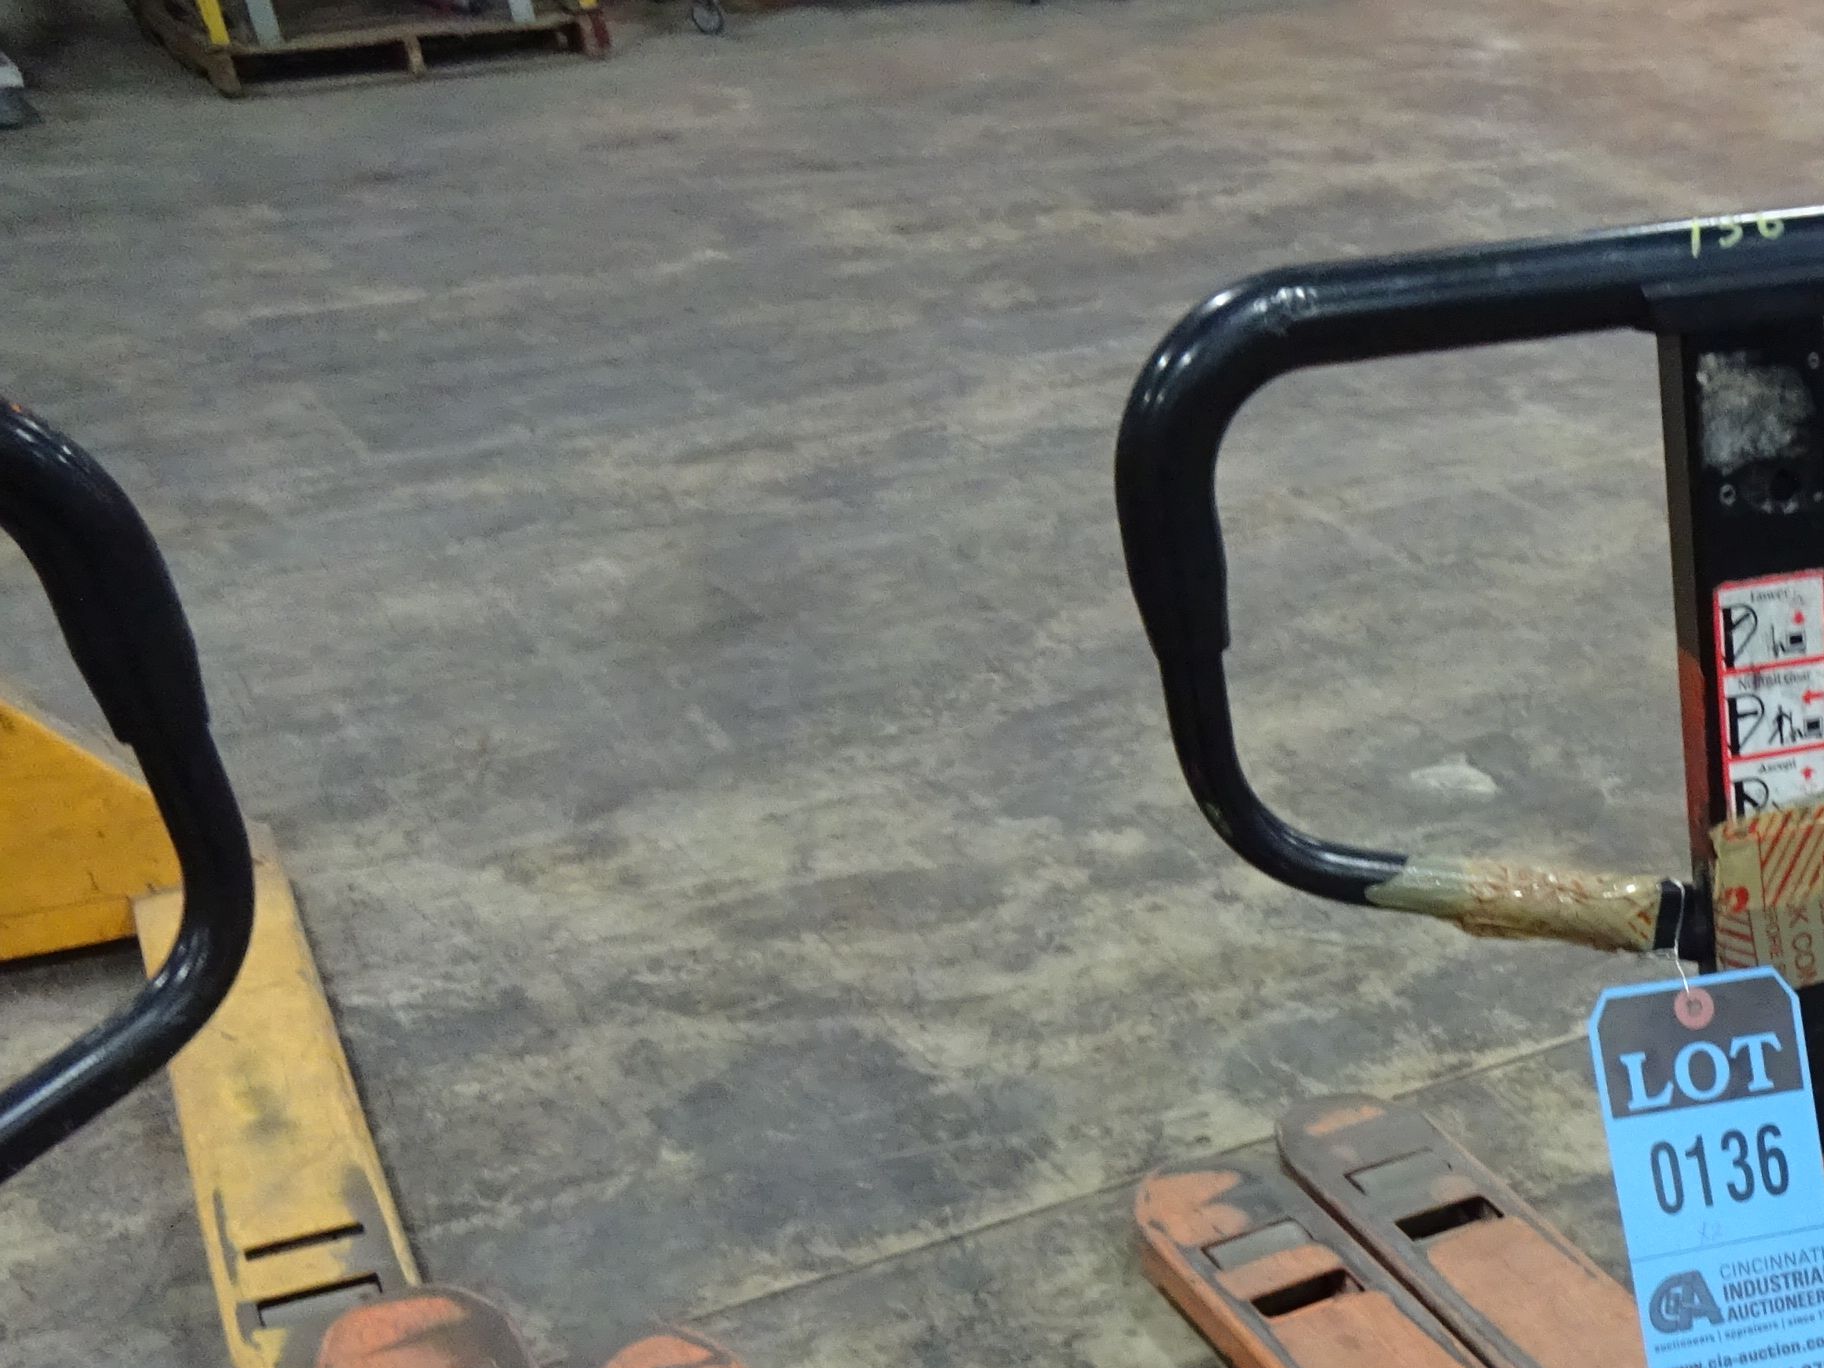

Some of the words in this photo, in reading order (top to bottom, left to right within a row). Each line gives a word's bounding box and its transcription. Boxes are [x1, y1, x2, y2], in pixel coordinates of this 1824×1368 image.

[1619, 1031, 1783, 1111] LOT
[1650, 1123, 1790, 1214] 0136
[1654, 1334, 1716, 1354] auctioneers
[1788, 1314, 1816, 1327] since
